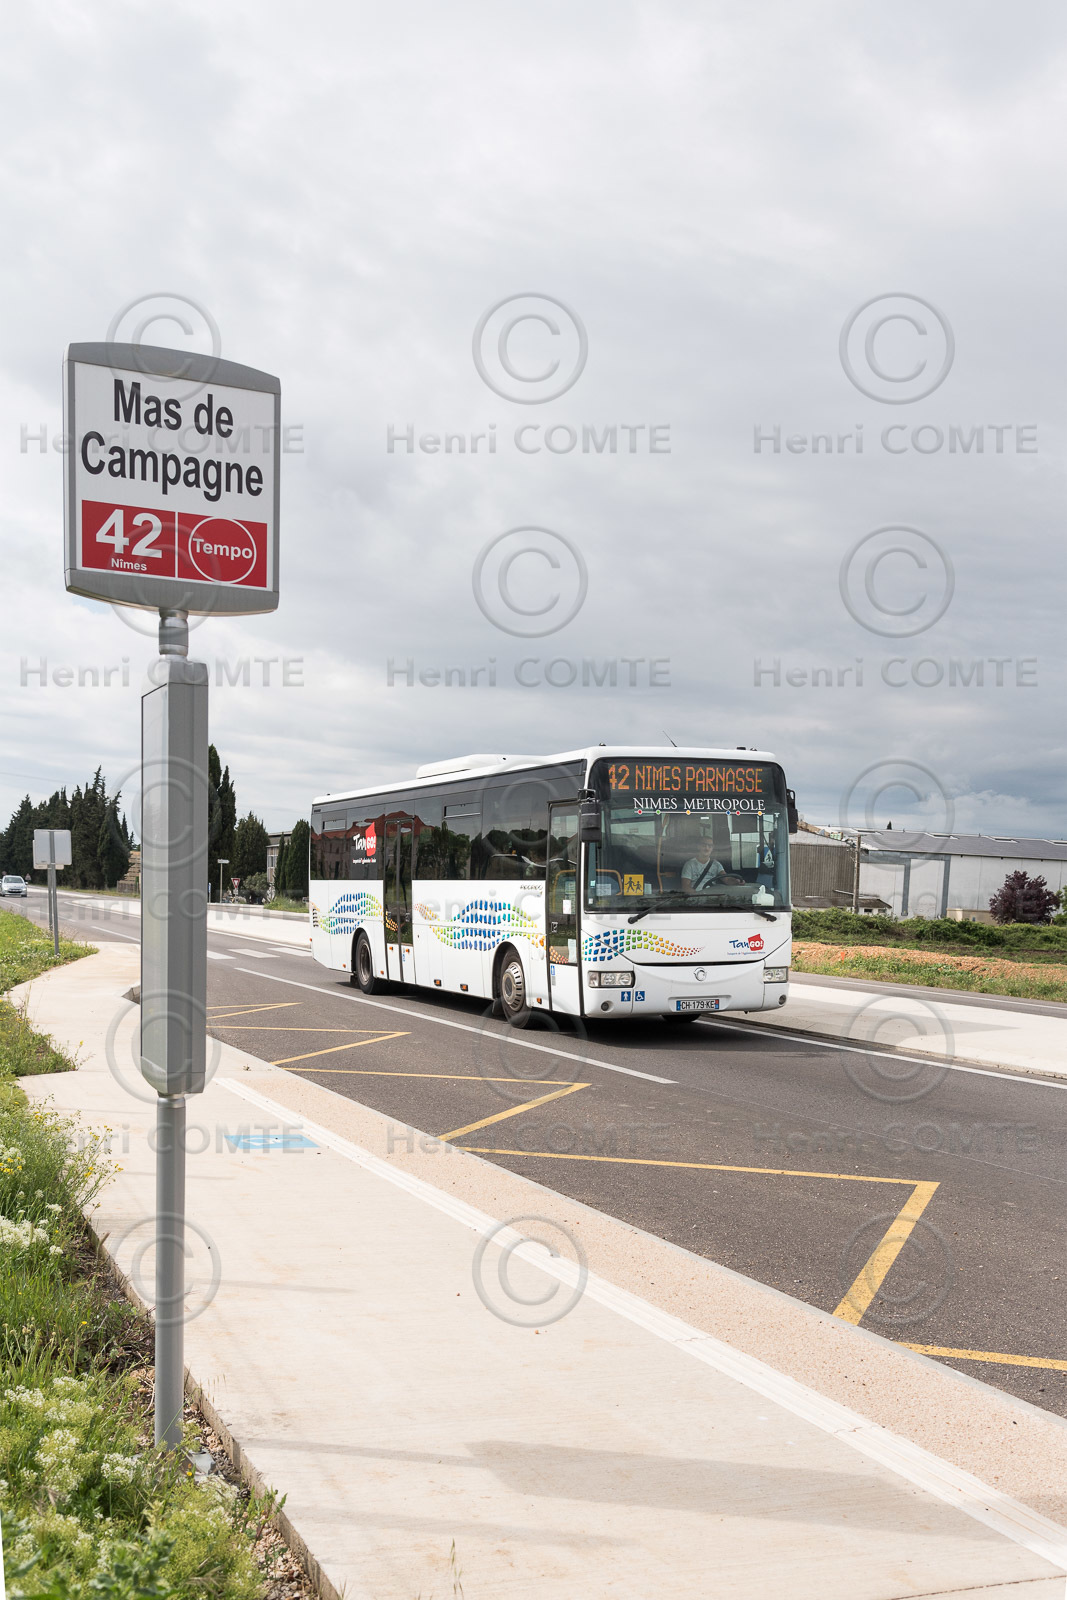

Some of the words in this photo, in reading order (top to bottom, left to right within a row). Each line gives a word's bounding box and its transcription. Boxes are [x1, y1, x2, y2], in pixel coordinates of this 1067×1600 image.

[114, 379, 182, 431] Mas
[194, 394, 234, 438] de
[81, 431, 264, 501] Campagne
[96, 509, 162, 558] 42
[193, 538, 253, 560] Tempo
[111, 558, 147, 571] Nîmes
[635, 765, 681, 790] NIMES
[685, 767, 763, 793] PARNASSE
[633, 797, 678, 810] NIMES
[683, 798, 766, 811] METROPOLE
[681, 1001, 715, 1010] CH-179-KE
